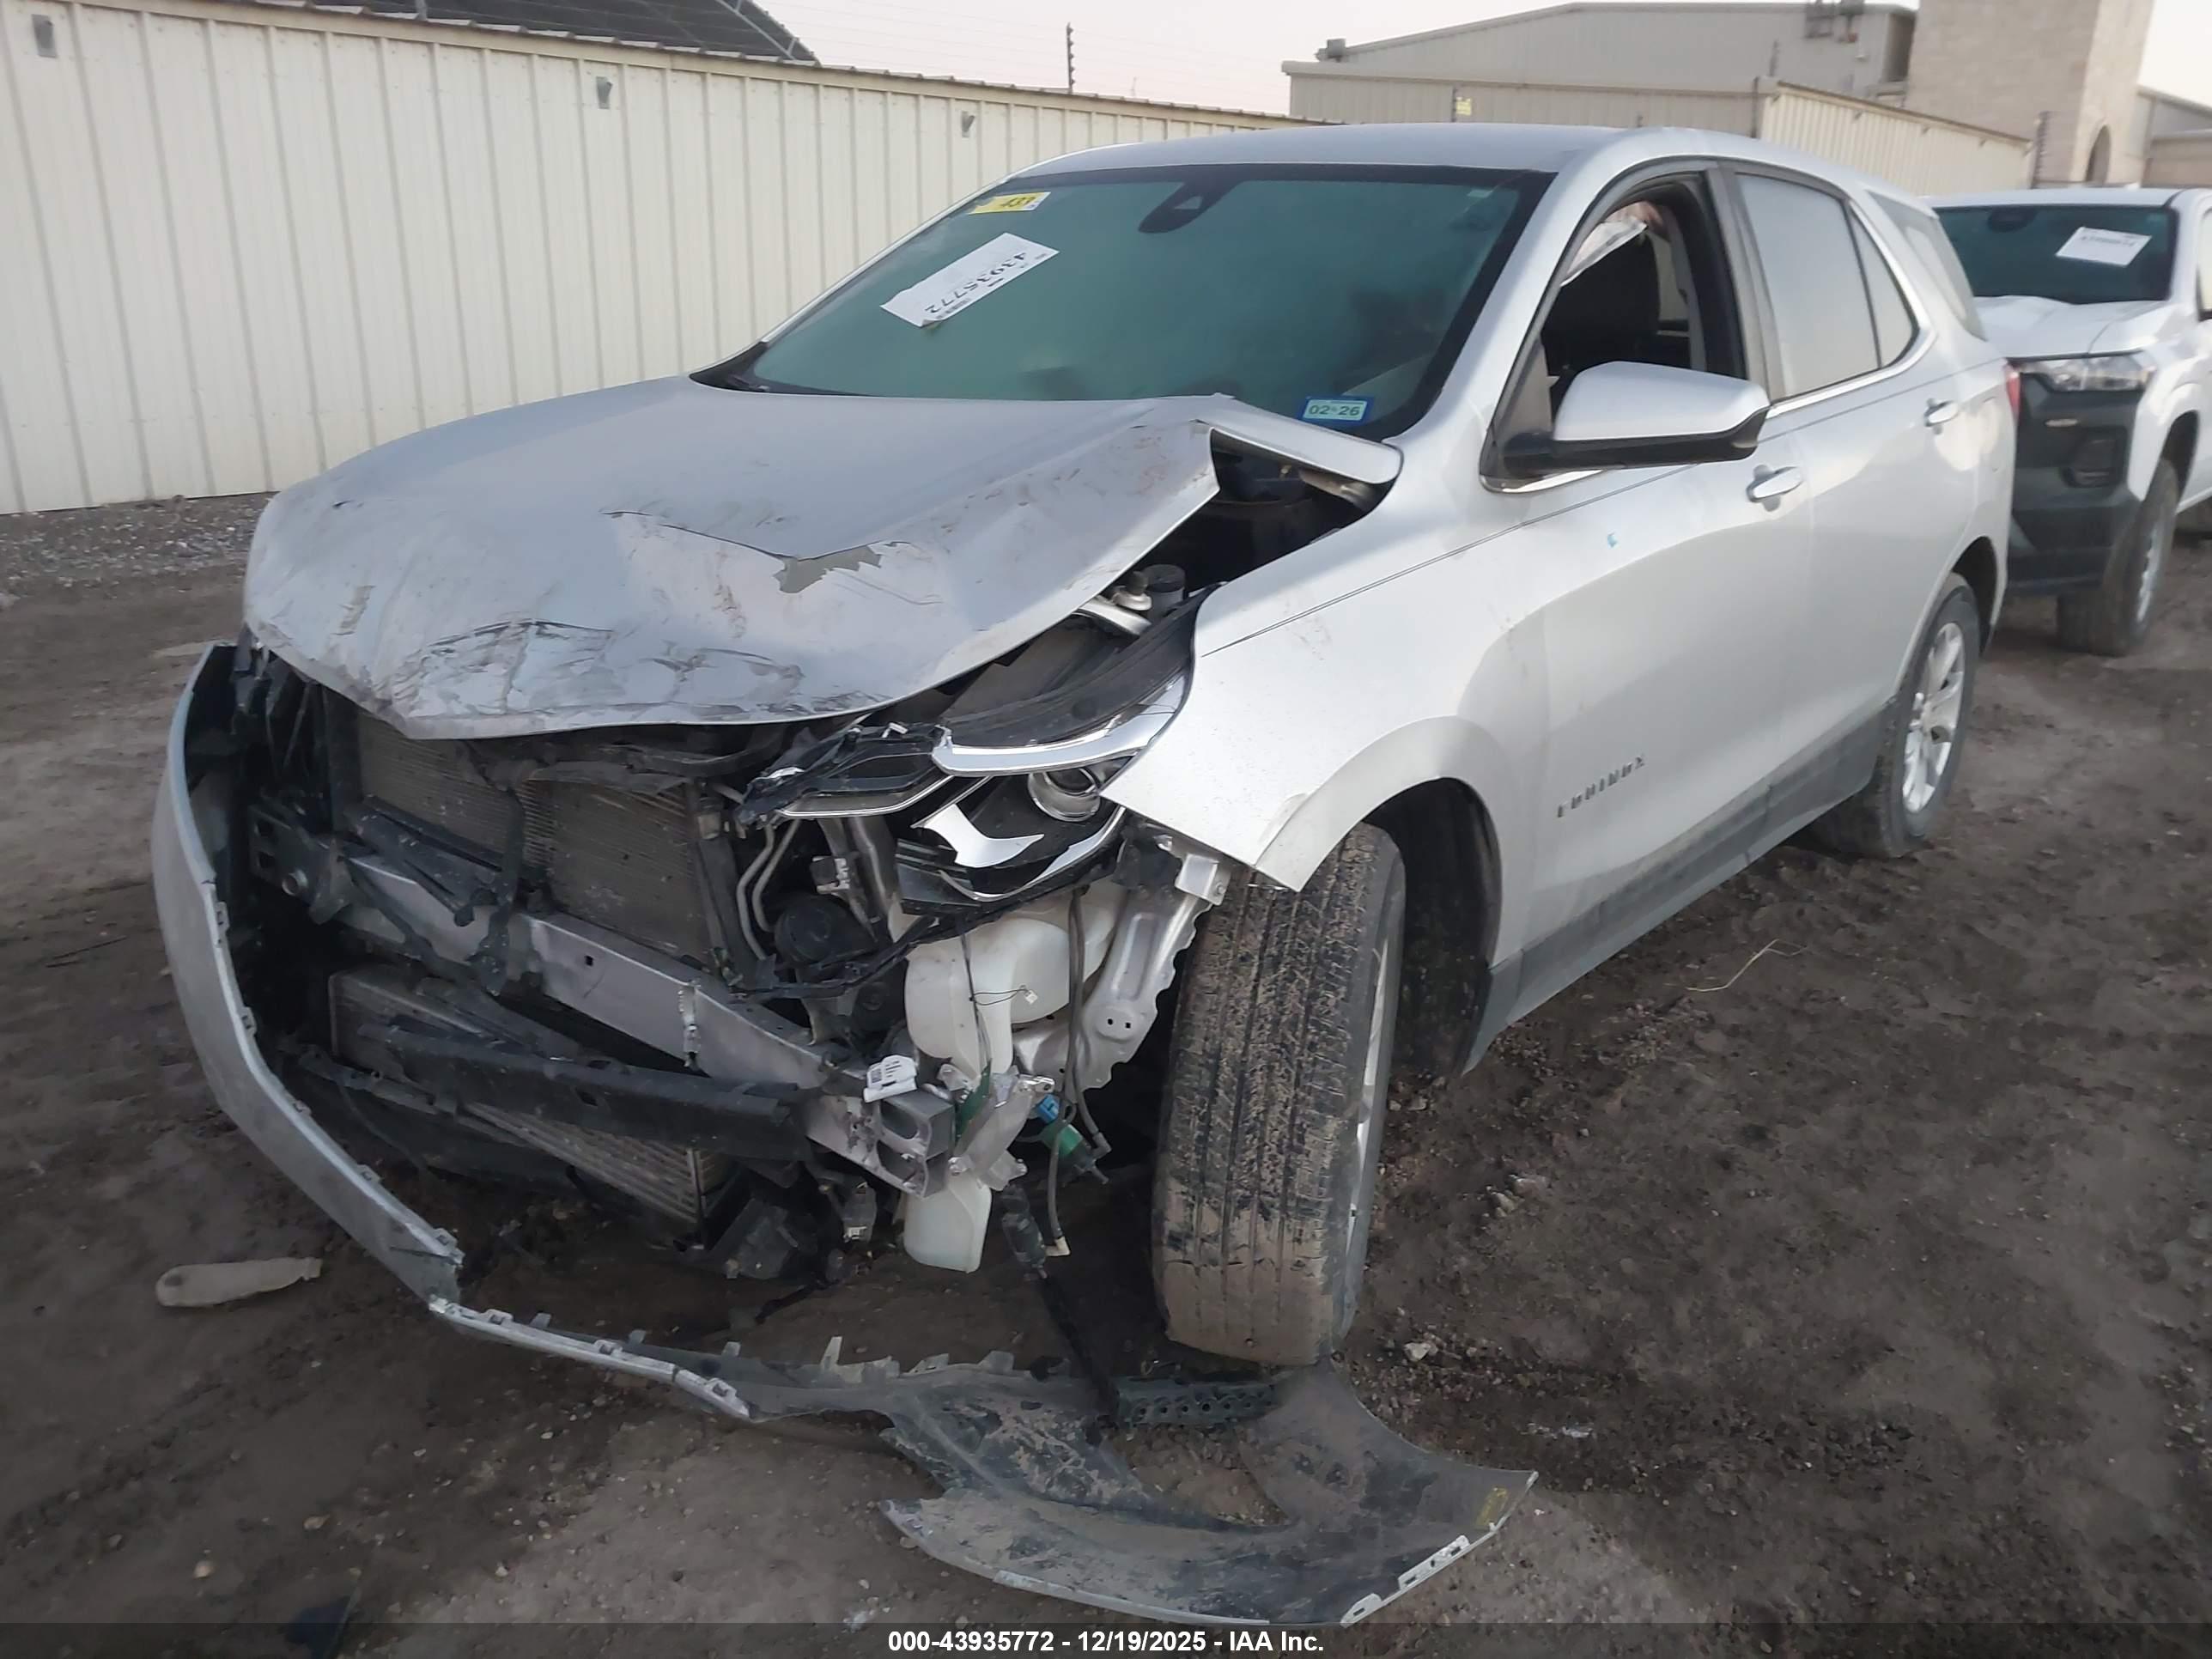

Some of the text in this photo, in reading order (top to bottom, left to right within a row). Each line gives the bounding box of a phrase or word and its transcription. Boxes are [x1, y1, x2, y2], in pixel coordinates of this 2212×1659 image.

[925, 252, 1026, 313] 43935772
[1308, 404, 1361, 416] 02 26
